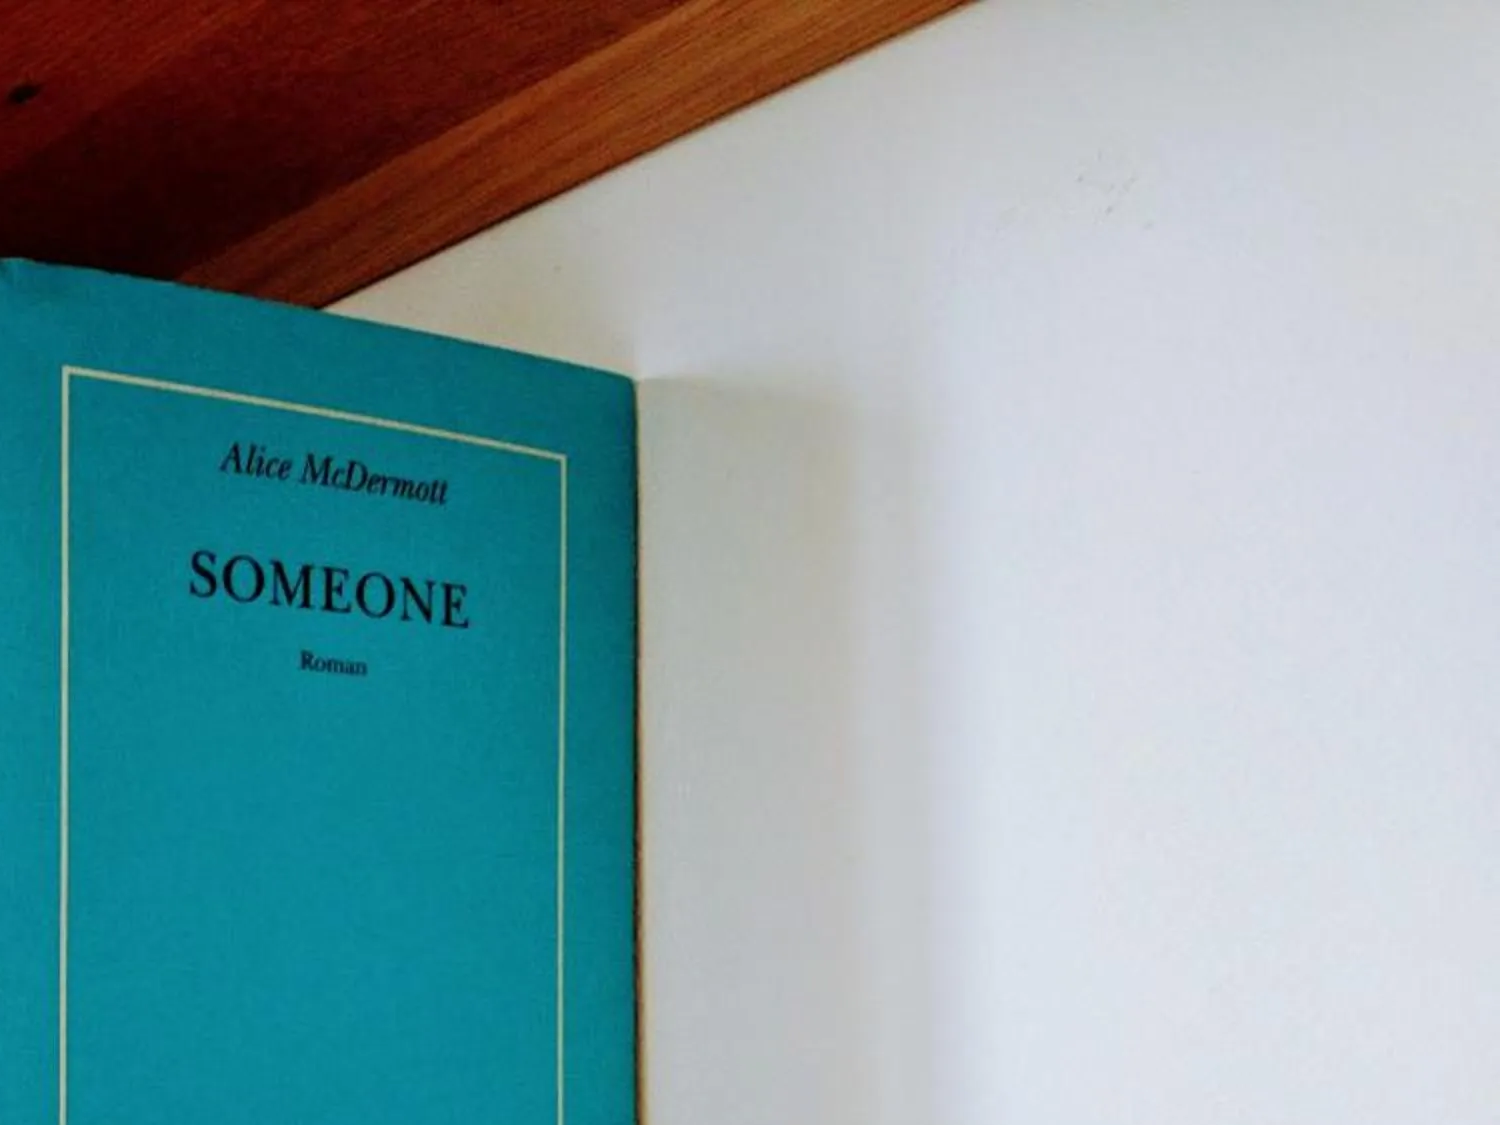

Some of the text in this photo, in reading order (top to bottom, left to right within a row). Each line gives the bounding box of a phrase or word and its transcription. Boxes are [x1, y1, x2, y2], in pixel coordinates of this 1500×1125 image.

[219, 441, 450, 506] Alice McDermott
[188, 549, 471, 630] SOMEONE
[299, 651, 369, 677] Roman
